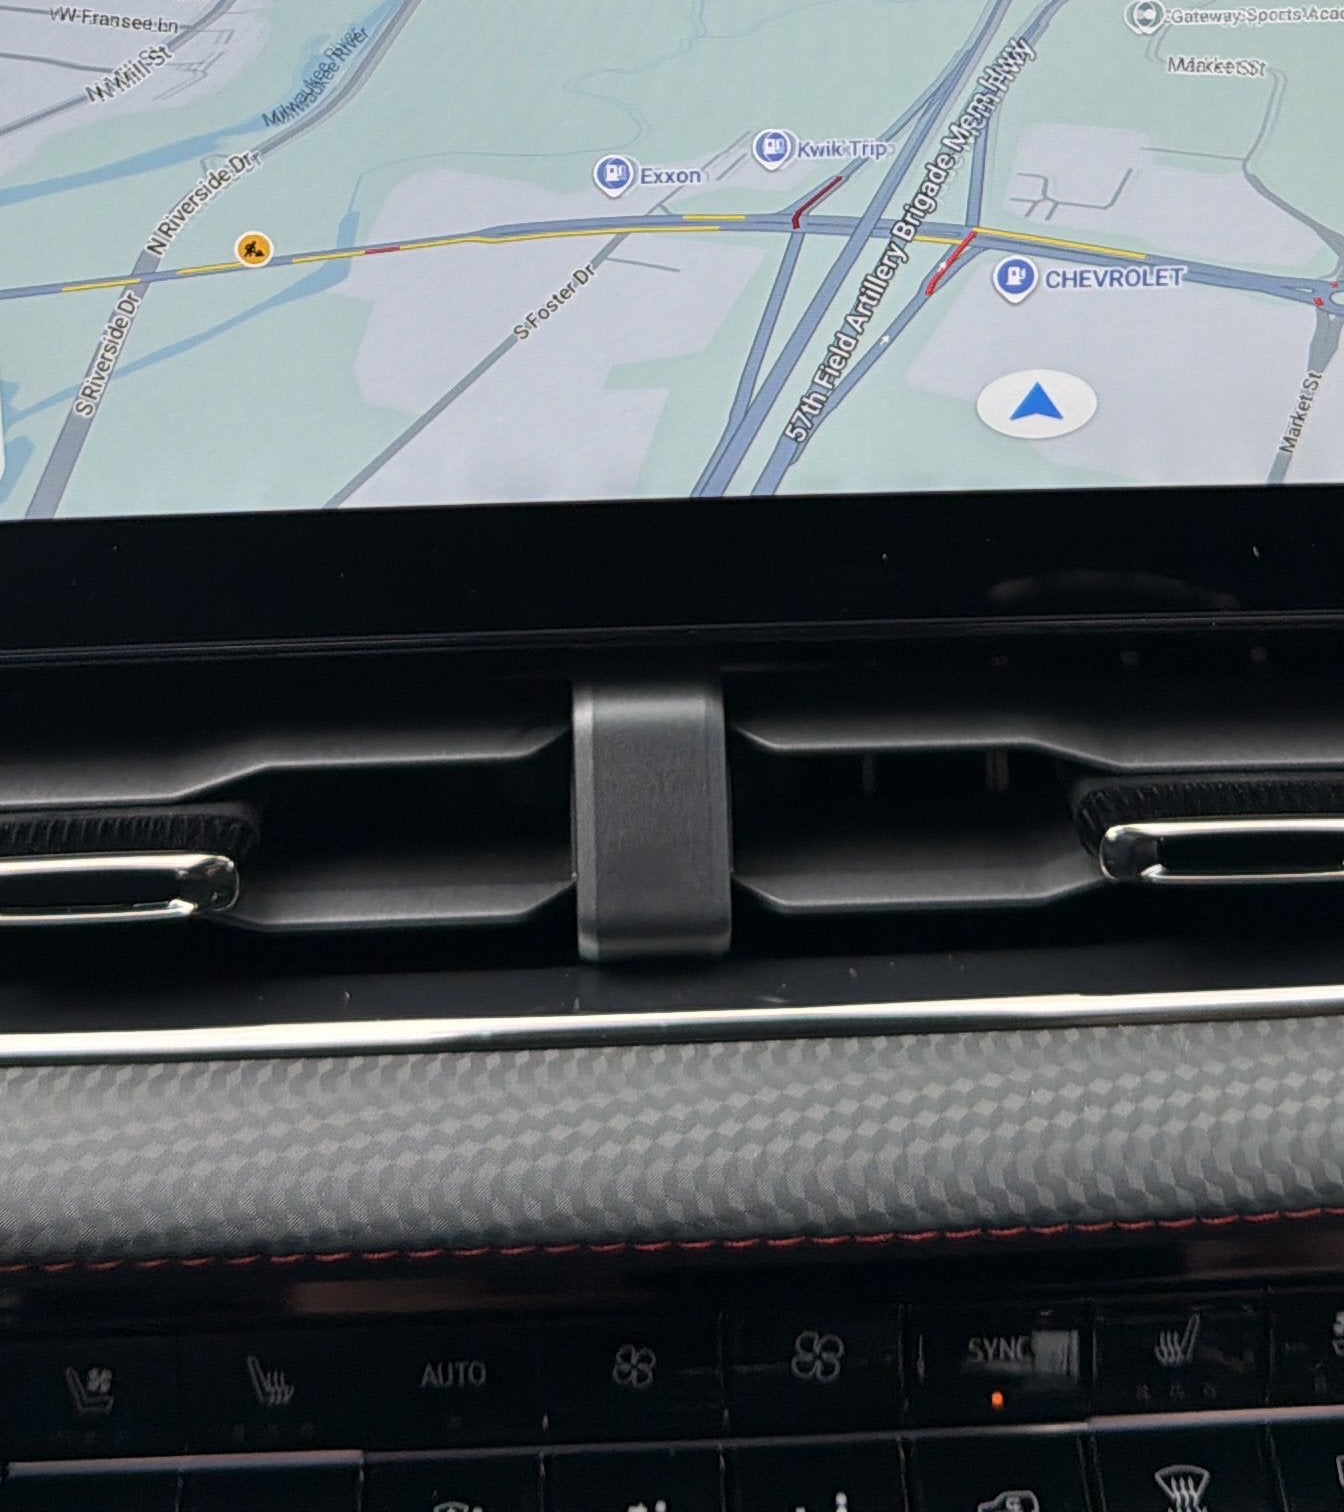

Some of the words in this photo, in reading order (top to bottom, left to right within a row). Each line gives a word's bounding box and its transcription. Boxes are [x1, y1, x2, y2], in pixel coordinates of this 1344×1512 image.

[59, 7, 76, 22] W
[1173, 8, 1241, 26] Gateway
[1248, 7, 1302, 24] Sports
[326, 27, 368, 62] River
[798, 140, 843, 157] Kwik
[849, 140, 887, 160] Trip
[641, 167, 701, 185] Exxon
[146, 236, 166, 257] N
[157, 168, 232, 239] Riverside
[228, 151, 253, 173] Dr
[784, 386, 827, 443] 57th
[813, 326, 859, 391] Field
[846, 234, 909, 330] Artillery
[892, 154, 956, 242] Brigade
[942, 92, 993, 152] Mem
[1045, 266, 1185, 289] CHEVROLET
[117, 292, 139, 316] Dr
[513, 324, 530, 340] S
[525, 282, 576, 328] Foster
[572, 264, 595, 285] Dr
[82, 315, 129, 401] Riverside
[75, 400, 94, 417] S
[1278, 394, 1313, 453] Market
[1302, 372, 1323, 391] St
[421, 1361, 487, 1387] AUTO
